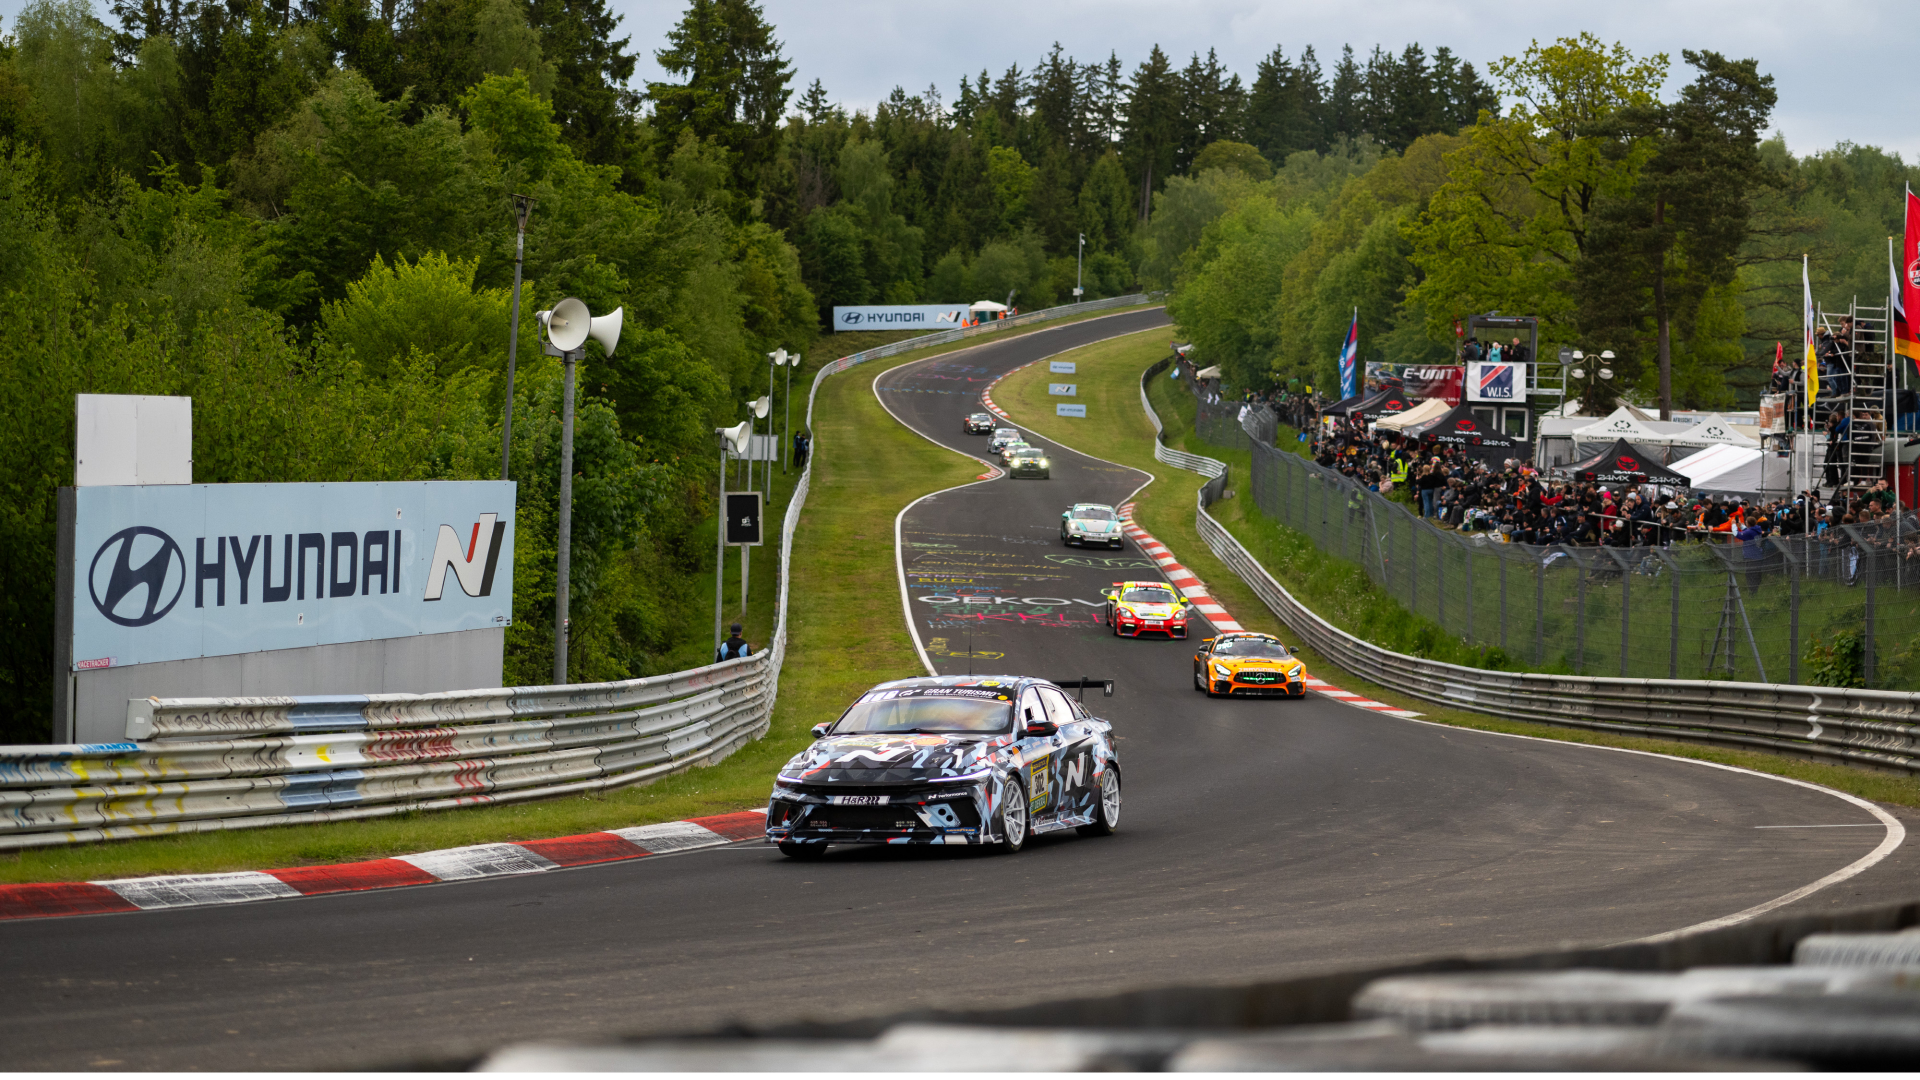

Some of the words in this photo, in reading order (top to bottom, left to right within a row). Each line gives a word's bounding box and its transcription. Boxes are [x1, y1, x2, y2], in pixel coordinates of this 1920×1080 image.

[867, 312, 925, 323] HYUNDAI
[1403, 368, 1455, 380] E-UNIT
[1486, 386, 1512, 398] W.I.S.
[1437, 435, 1466, 444] 24MX
[1482, 439, 1510, 447] 24MX
[1597, 474, 1629, 482] 24MX
[1649, 476, 1682, 485] 24MX
[194, 529, 402, 609] HYUNDAI
[923, 688, 952, 696] GRAN
[953, 688, 998, 697] TURISMO
[1034, 772, 1045, 795] 302
